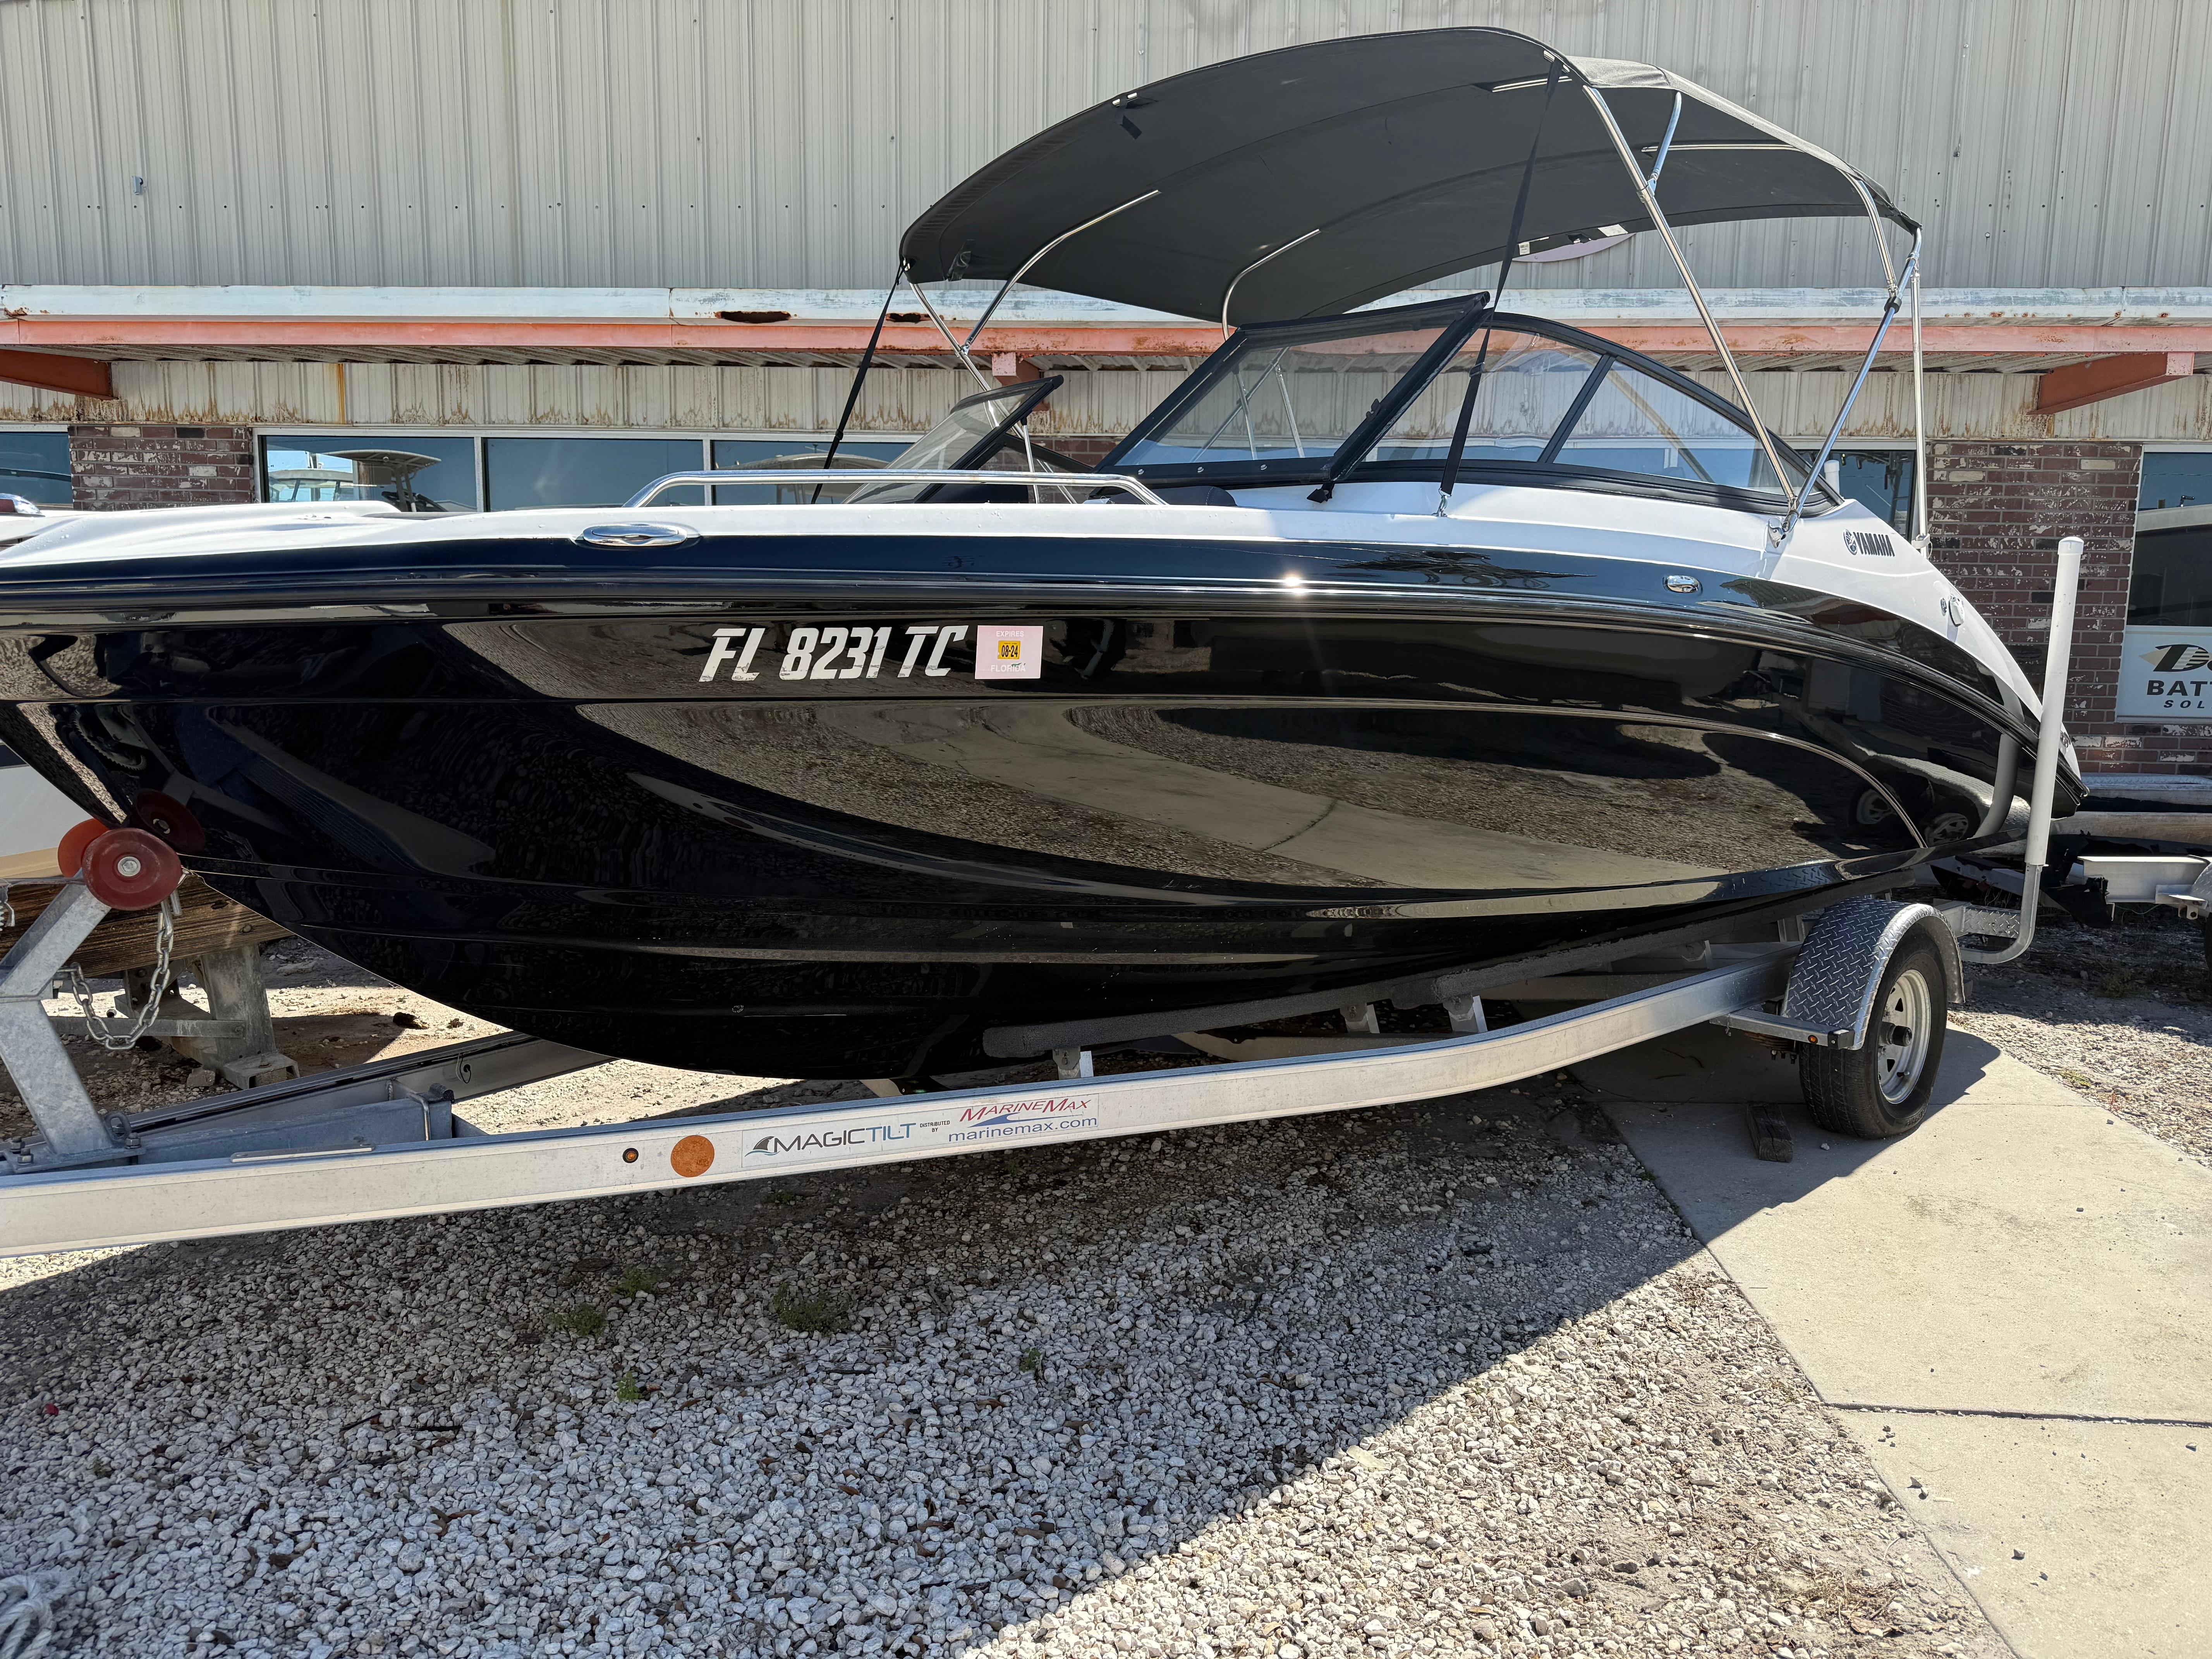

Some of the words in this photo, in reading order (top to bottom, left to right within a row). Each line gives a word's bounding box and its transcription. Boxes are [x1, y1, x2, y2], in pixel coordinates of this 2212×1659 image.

[1853, 532, 1895, 557] YAMAHA
[699, 628, 766, 682] FL
[779, 627, 892, 680] 8231
[897, 625, 969, 678] TC
[2153, 644, 2212, 672] D
[2147, 680, 2212, 696] BAT
[2164, 700, 2212, 709] SOL
[949, 1118, 1097, 1142] marinemax.com
